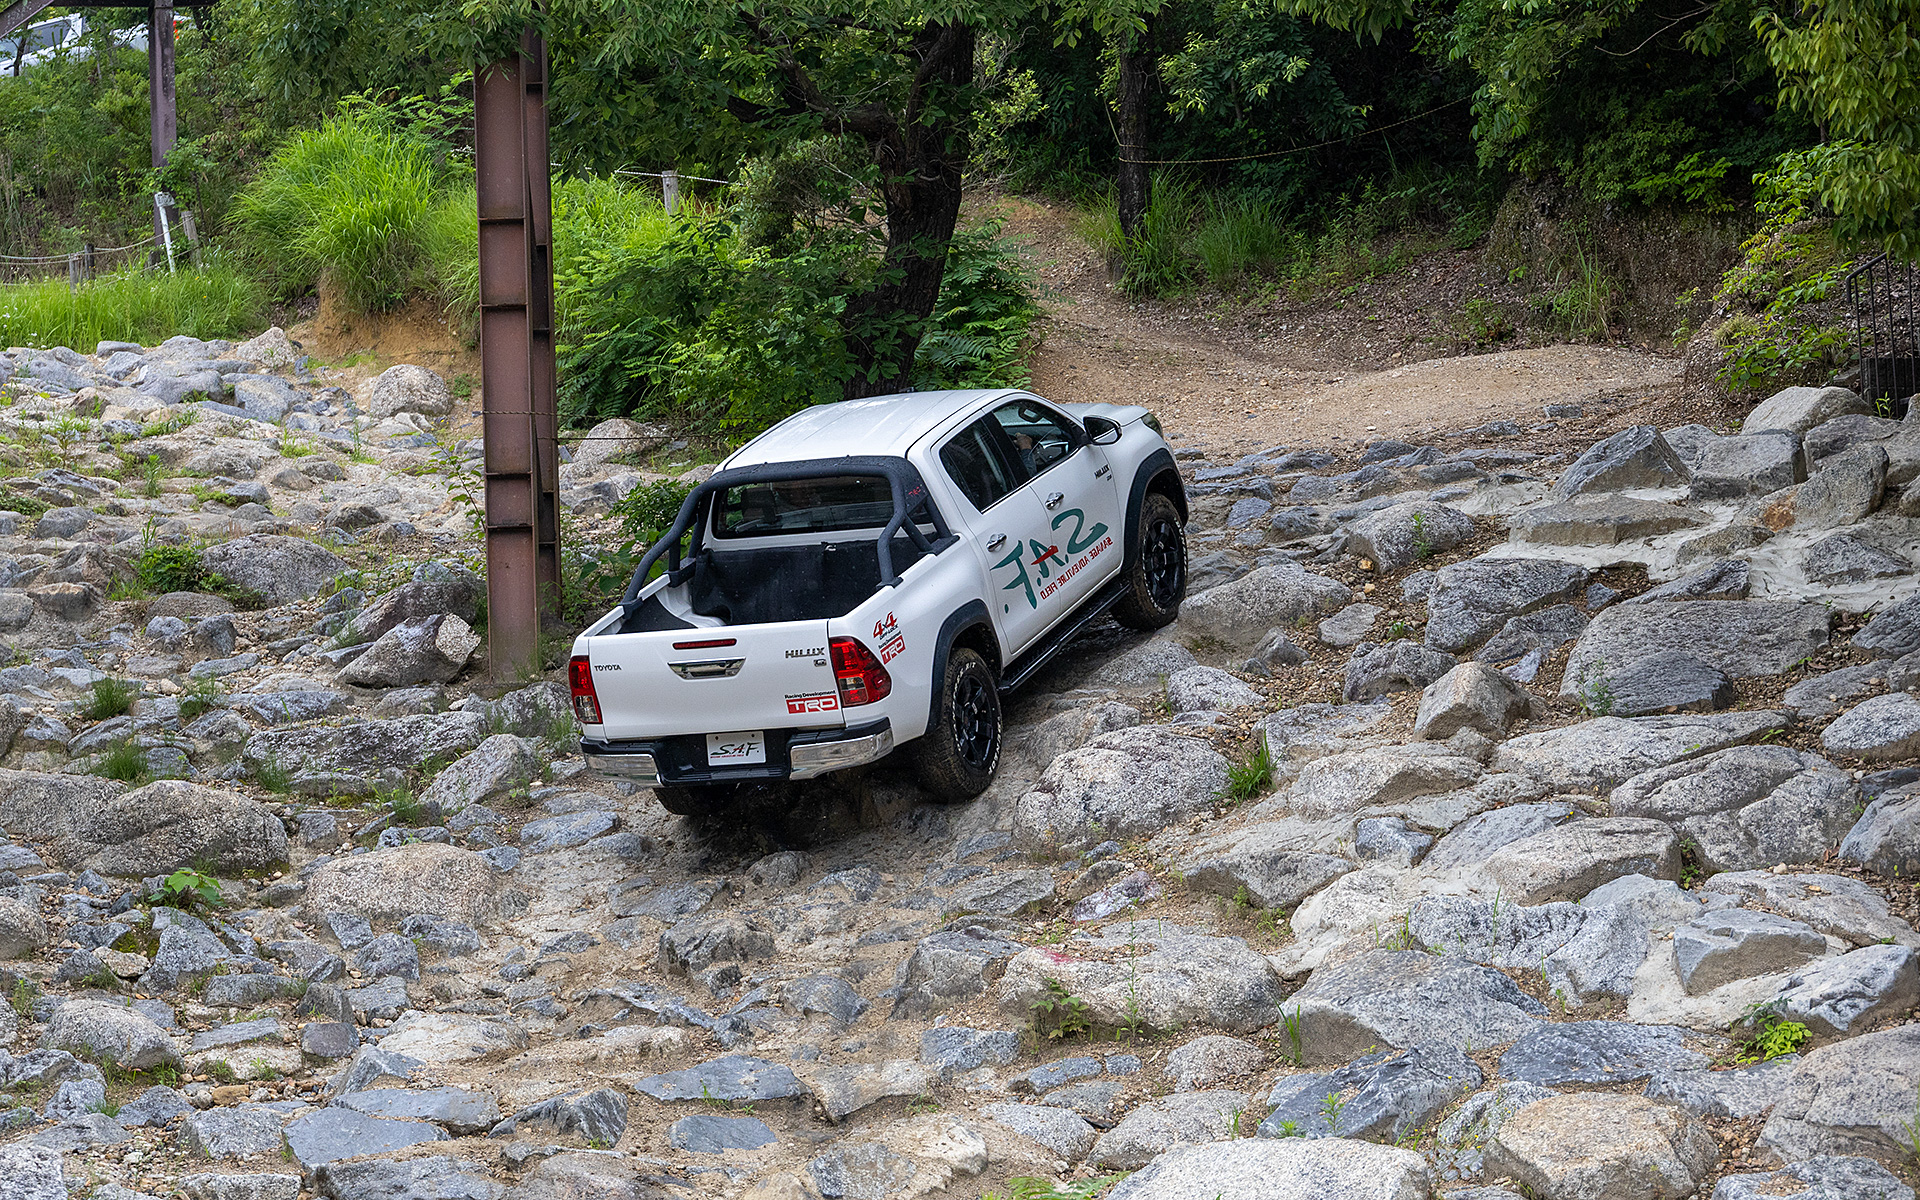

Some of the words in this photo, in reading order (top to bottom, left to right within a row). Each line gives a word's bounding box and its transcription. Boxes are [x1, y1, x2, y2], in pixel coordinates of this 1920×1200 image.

[785, 647, 825, 658] HILUX
[881, 638, 904, 662] TRD
[802, 690, 836, 698] Development
[788, 697, 836, 713] TRD
[710, 741, 761, 756] S.A.F.
